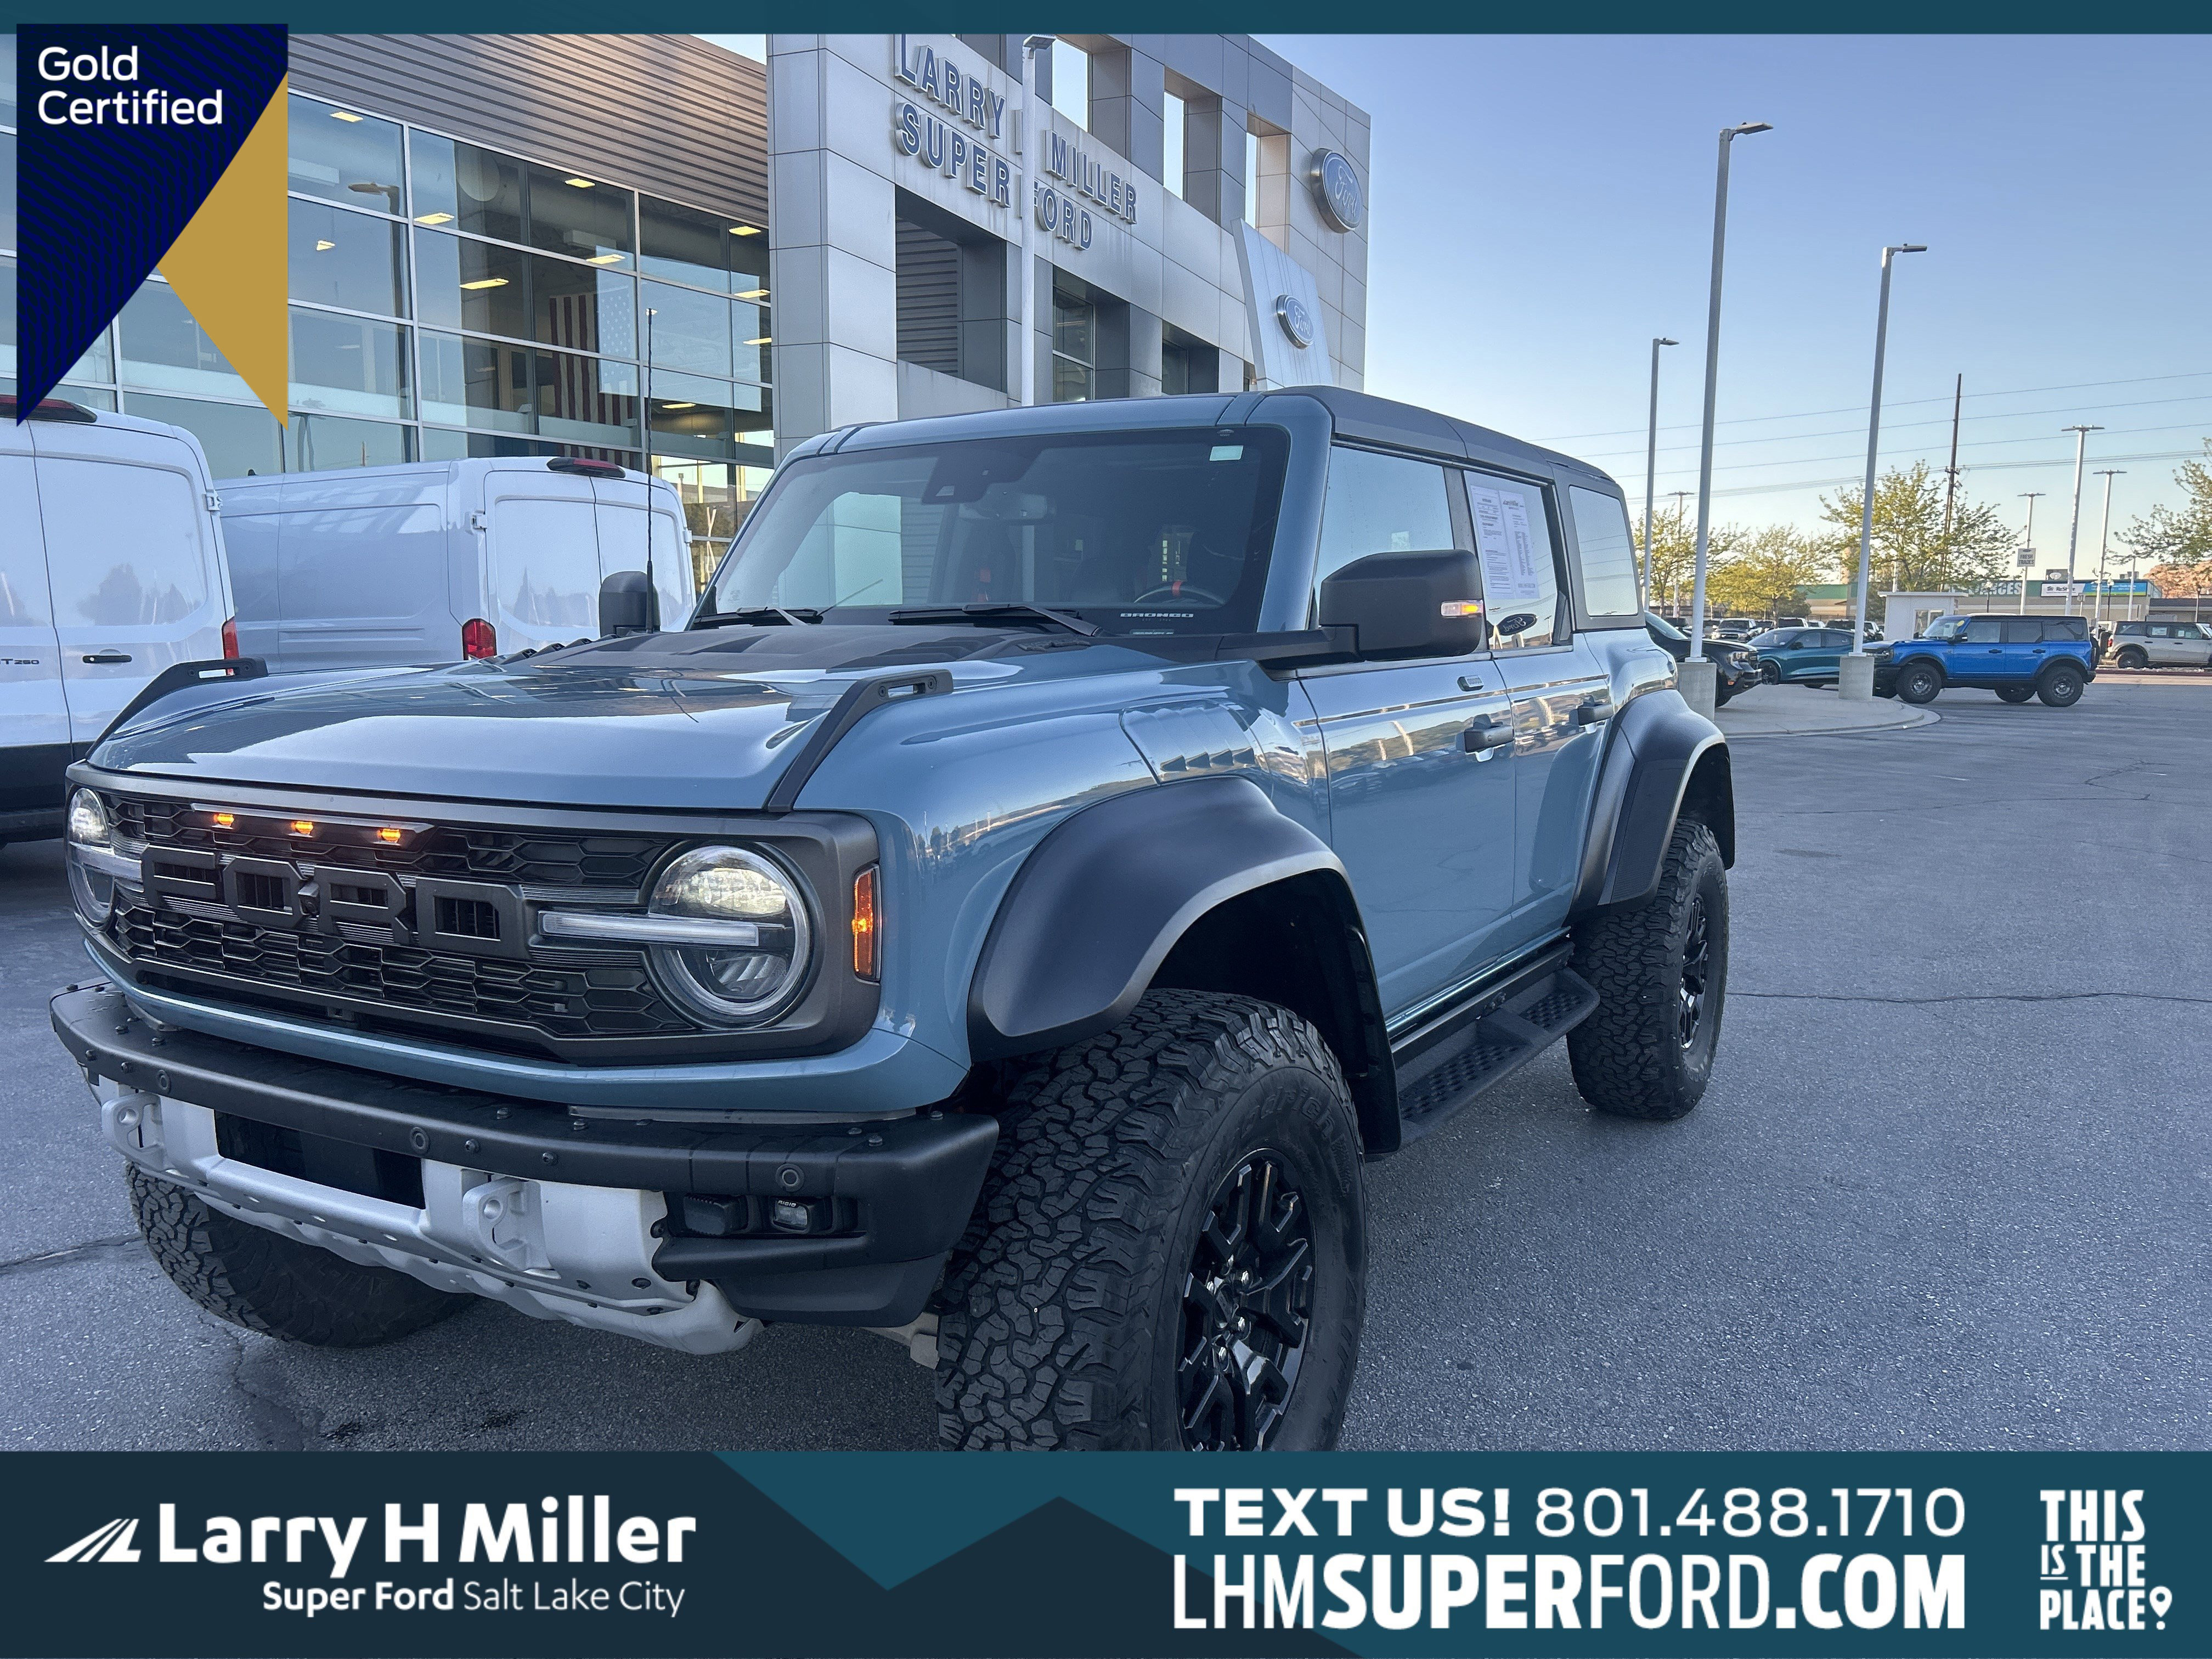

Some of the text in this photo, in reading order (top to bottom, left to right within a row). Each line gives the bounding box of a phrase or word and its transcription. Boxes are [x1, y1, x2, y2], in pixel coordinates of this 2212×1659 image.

[895, 34, 1006, 139] LARRY
[1045, 129, 1137, 224] MILLER
[895, 101, 1011, 208] SUPER
[1335, 166, 1358, 217] Ford
[1294, 305, 1311, 337] Ford
[141, 845, 530, 959] FORD
